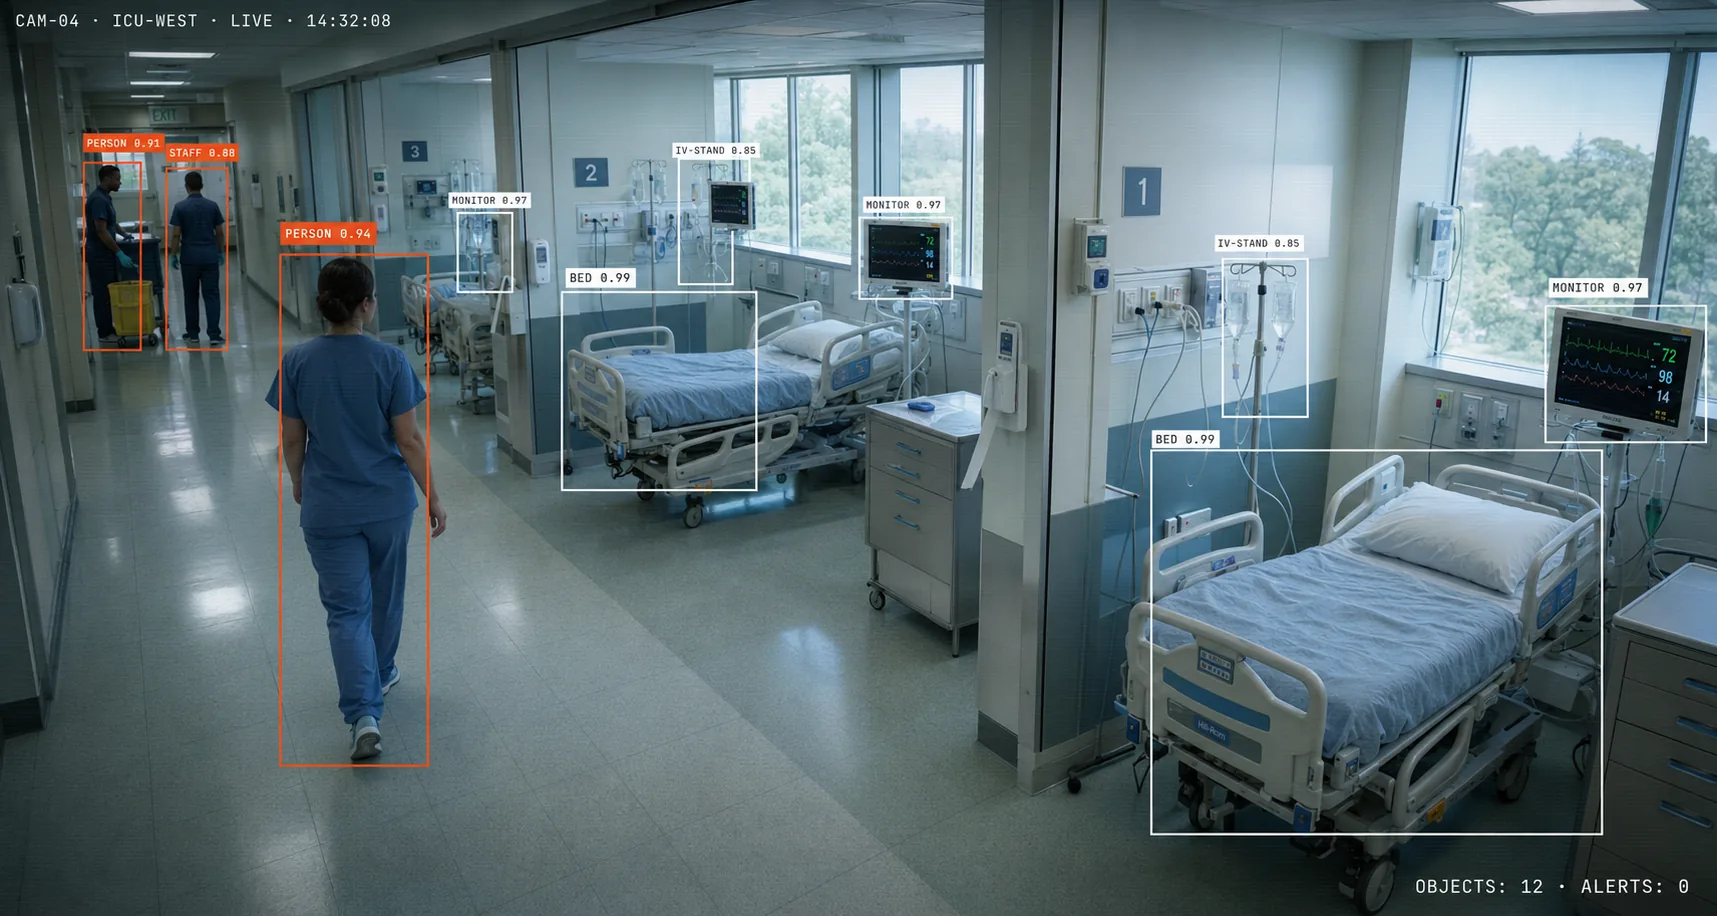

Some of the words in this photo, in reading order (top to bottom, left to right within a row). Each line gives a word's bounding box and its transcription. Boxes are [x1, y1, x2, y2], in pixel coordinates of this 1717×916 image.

[152, 108, 176, 122] EXIT
[410, 145, 420, 159] 3
[585, 163, 598, 182] 2
[1138, 177, 1147, 206] 1
[1662, 347, 1677, 364] 72
[1658, 369, 1673, 385] 98
[1656, 389, 1670, 404] 14
